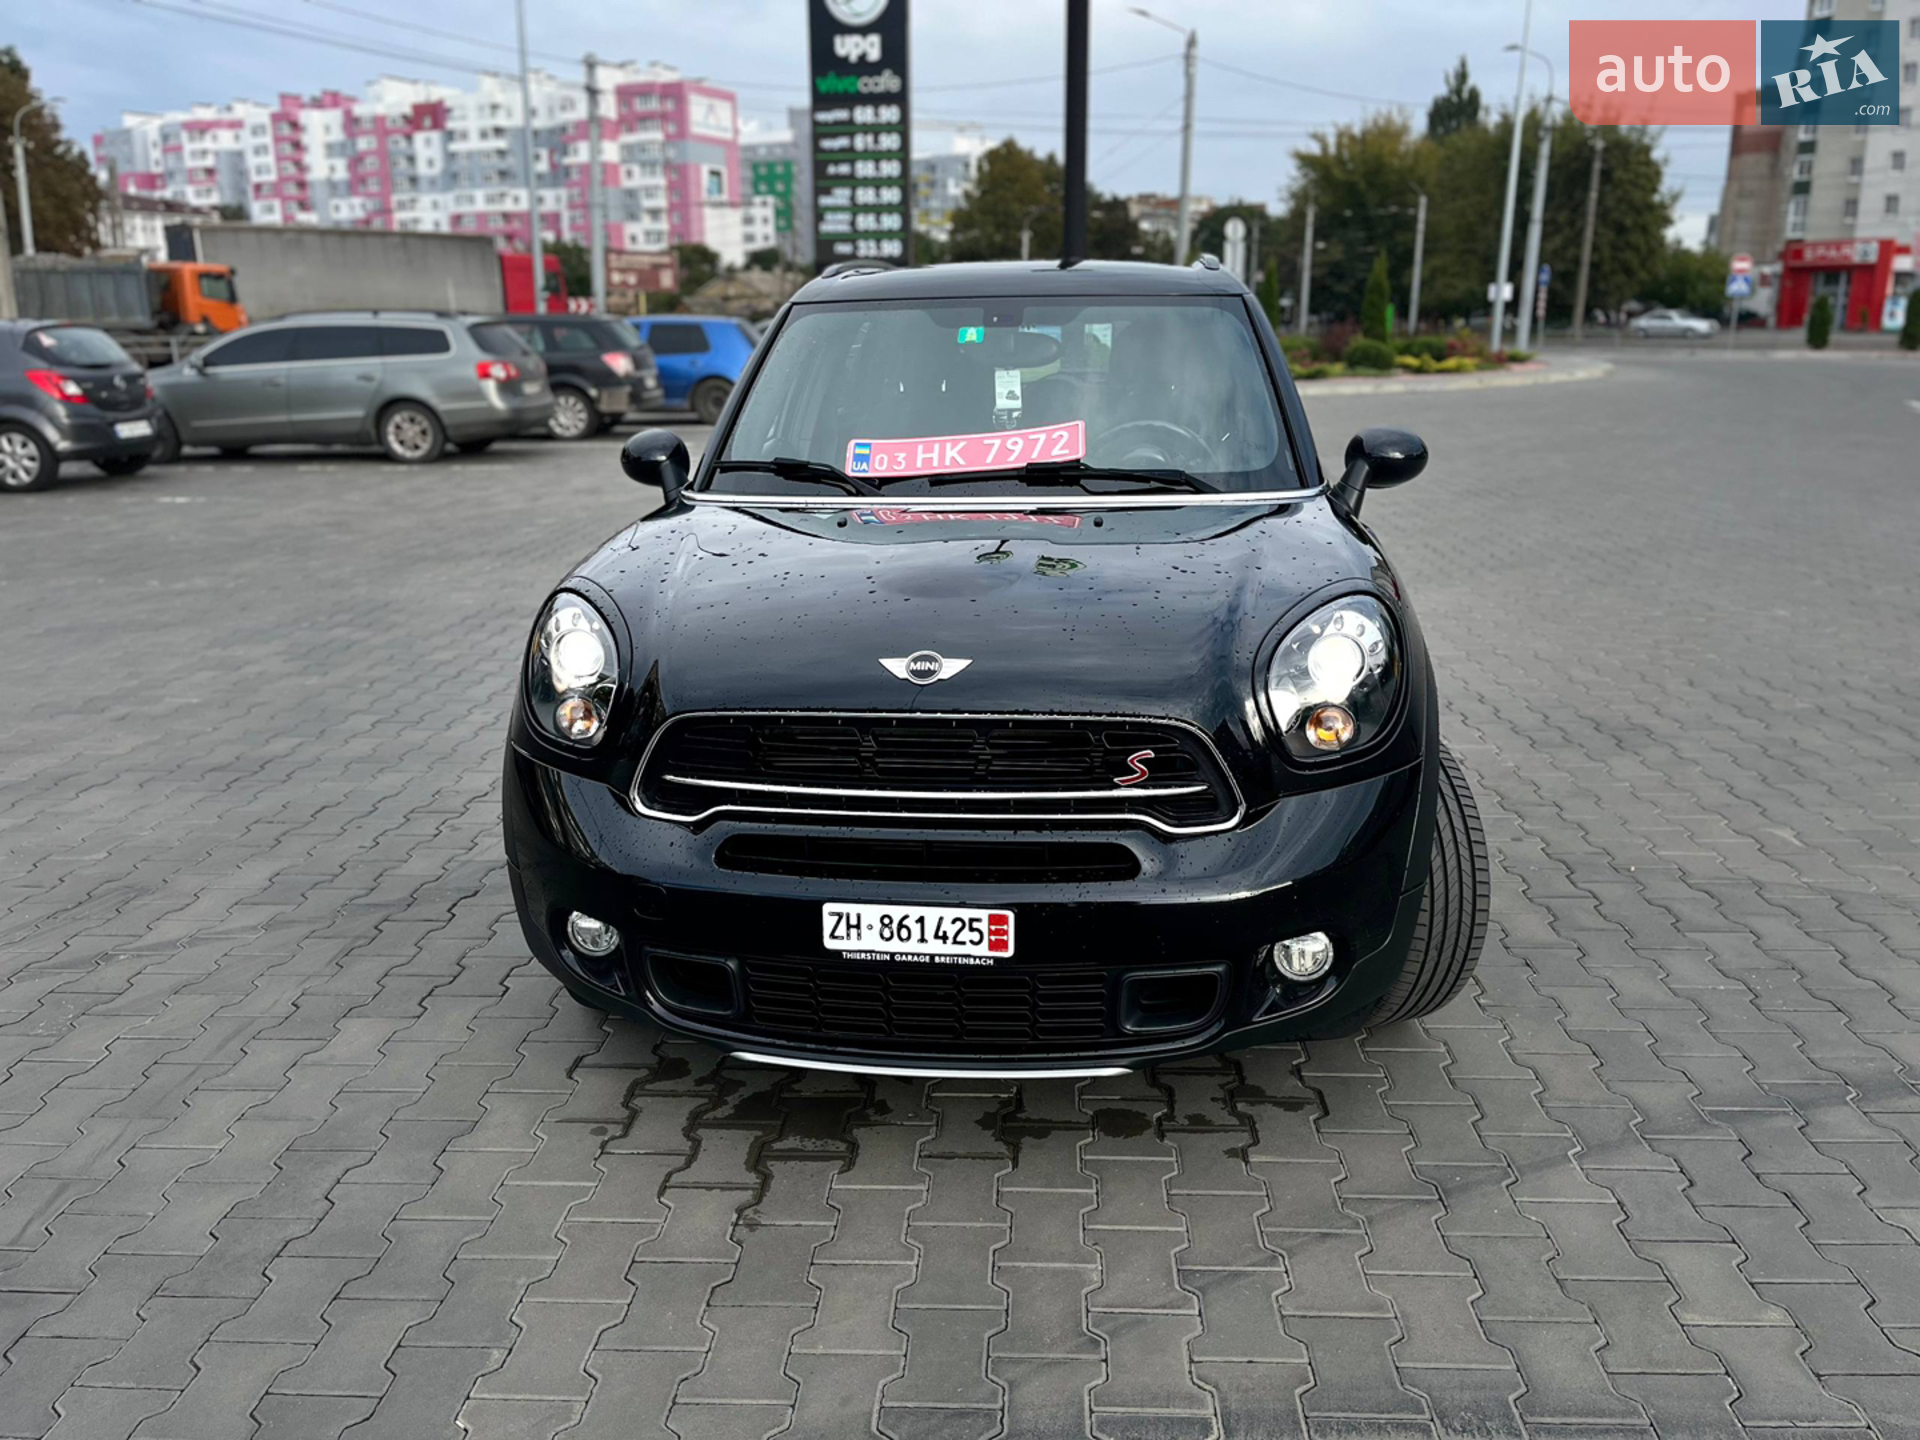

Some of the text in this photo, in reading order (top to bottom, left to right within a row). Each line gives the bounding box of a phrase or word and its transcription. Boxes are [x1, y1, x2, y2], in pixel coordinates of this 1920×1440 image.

[833, 32, 882, 64] upg
[852, 430, 1070, 471] UA 03 HK 7972
[910, 661, 939, 671] MINI
[1113, 749, 1155, 786] S
[842, 951, 994, 966] THIERSTEIN GARAGE BREITENBACH
